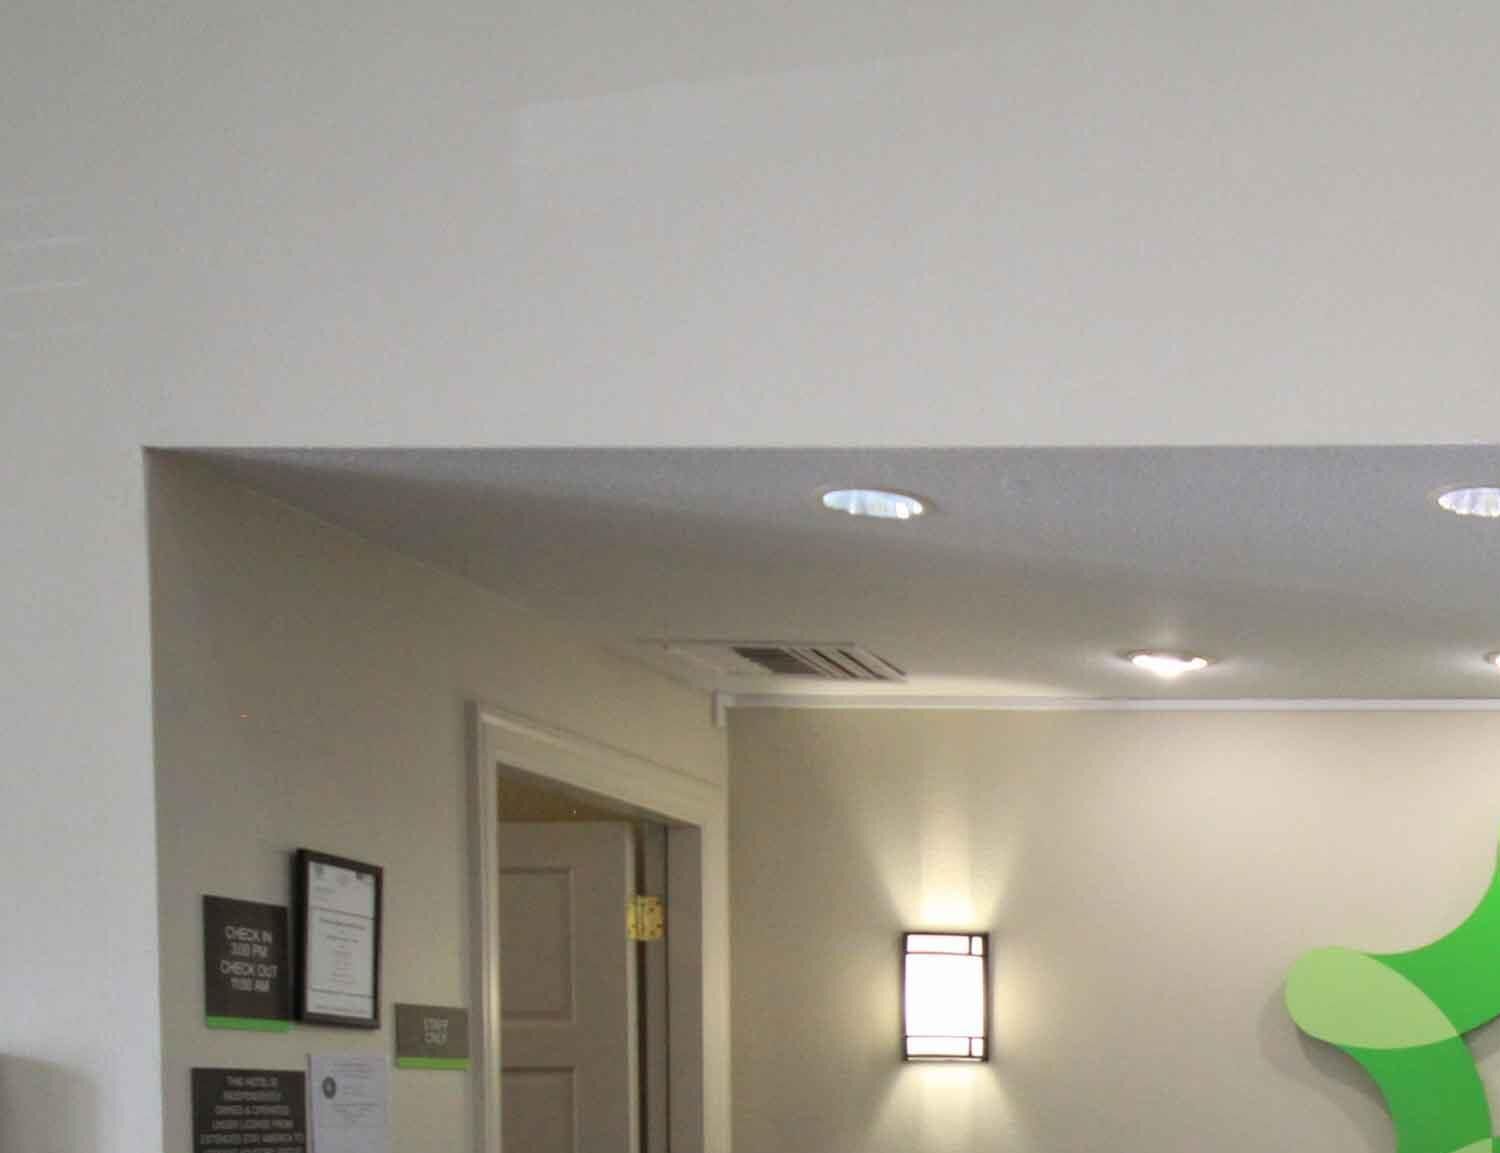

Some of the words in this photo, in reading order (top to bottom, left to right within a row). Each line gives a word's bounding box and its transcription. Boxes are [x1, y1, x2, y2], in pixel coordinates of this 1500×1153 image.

[224, 925, 260, 942] CHECK
[262, 930, 273, 944] IN
[252, 944, 269, 958] PM
[219, 959, 254, 977] CHECK
[257, 963, 278, 979] OUT
